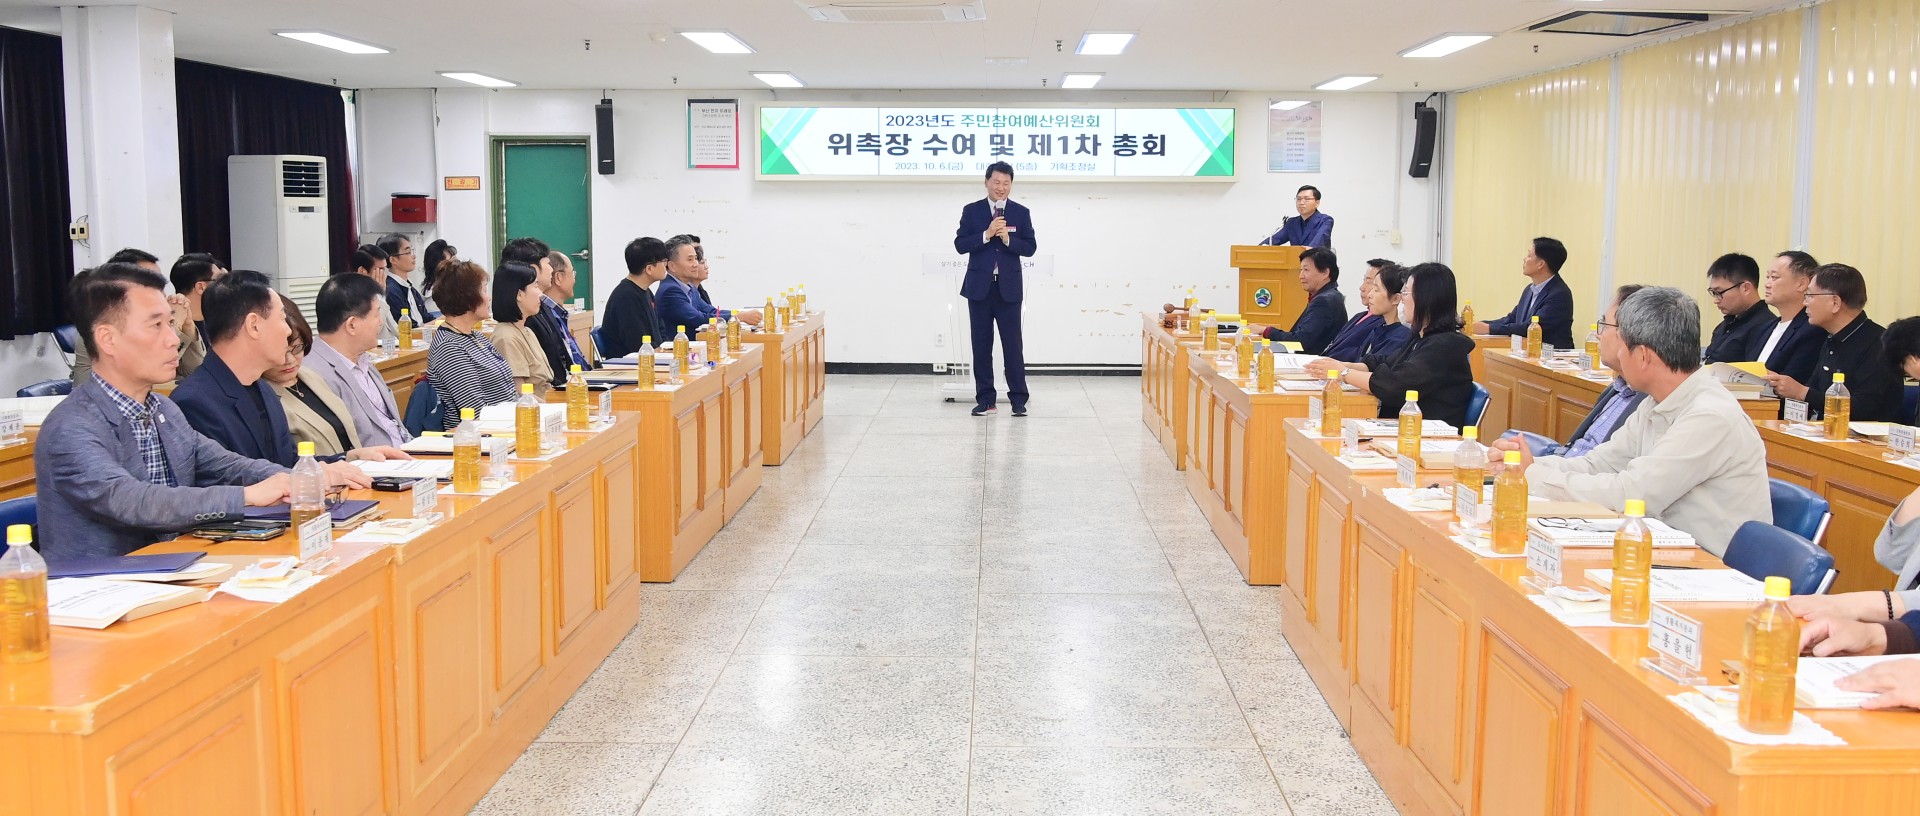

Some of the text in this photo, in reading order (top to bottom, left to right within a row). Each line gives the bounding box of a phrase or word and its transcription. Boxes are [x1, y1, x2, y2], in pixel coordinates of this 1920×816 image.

[886, 114, 1101, 129] 2023년도 주민참여예산위원회
[827, 132, 1166, 157] 위촉장 수여 및 제1차 총회
[895, 162, 920, 171] 2023.
[924, 162, 937, 171] 10.
[1050, 162, 1096, 171] 기획조정실
